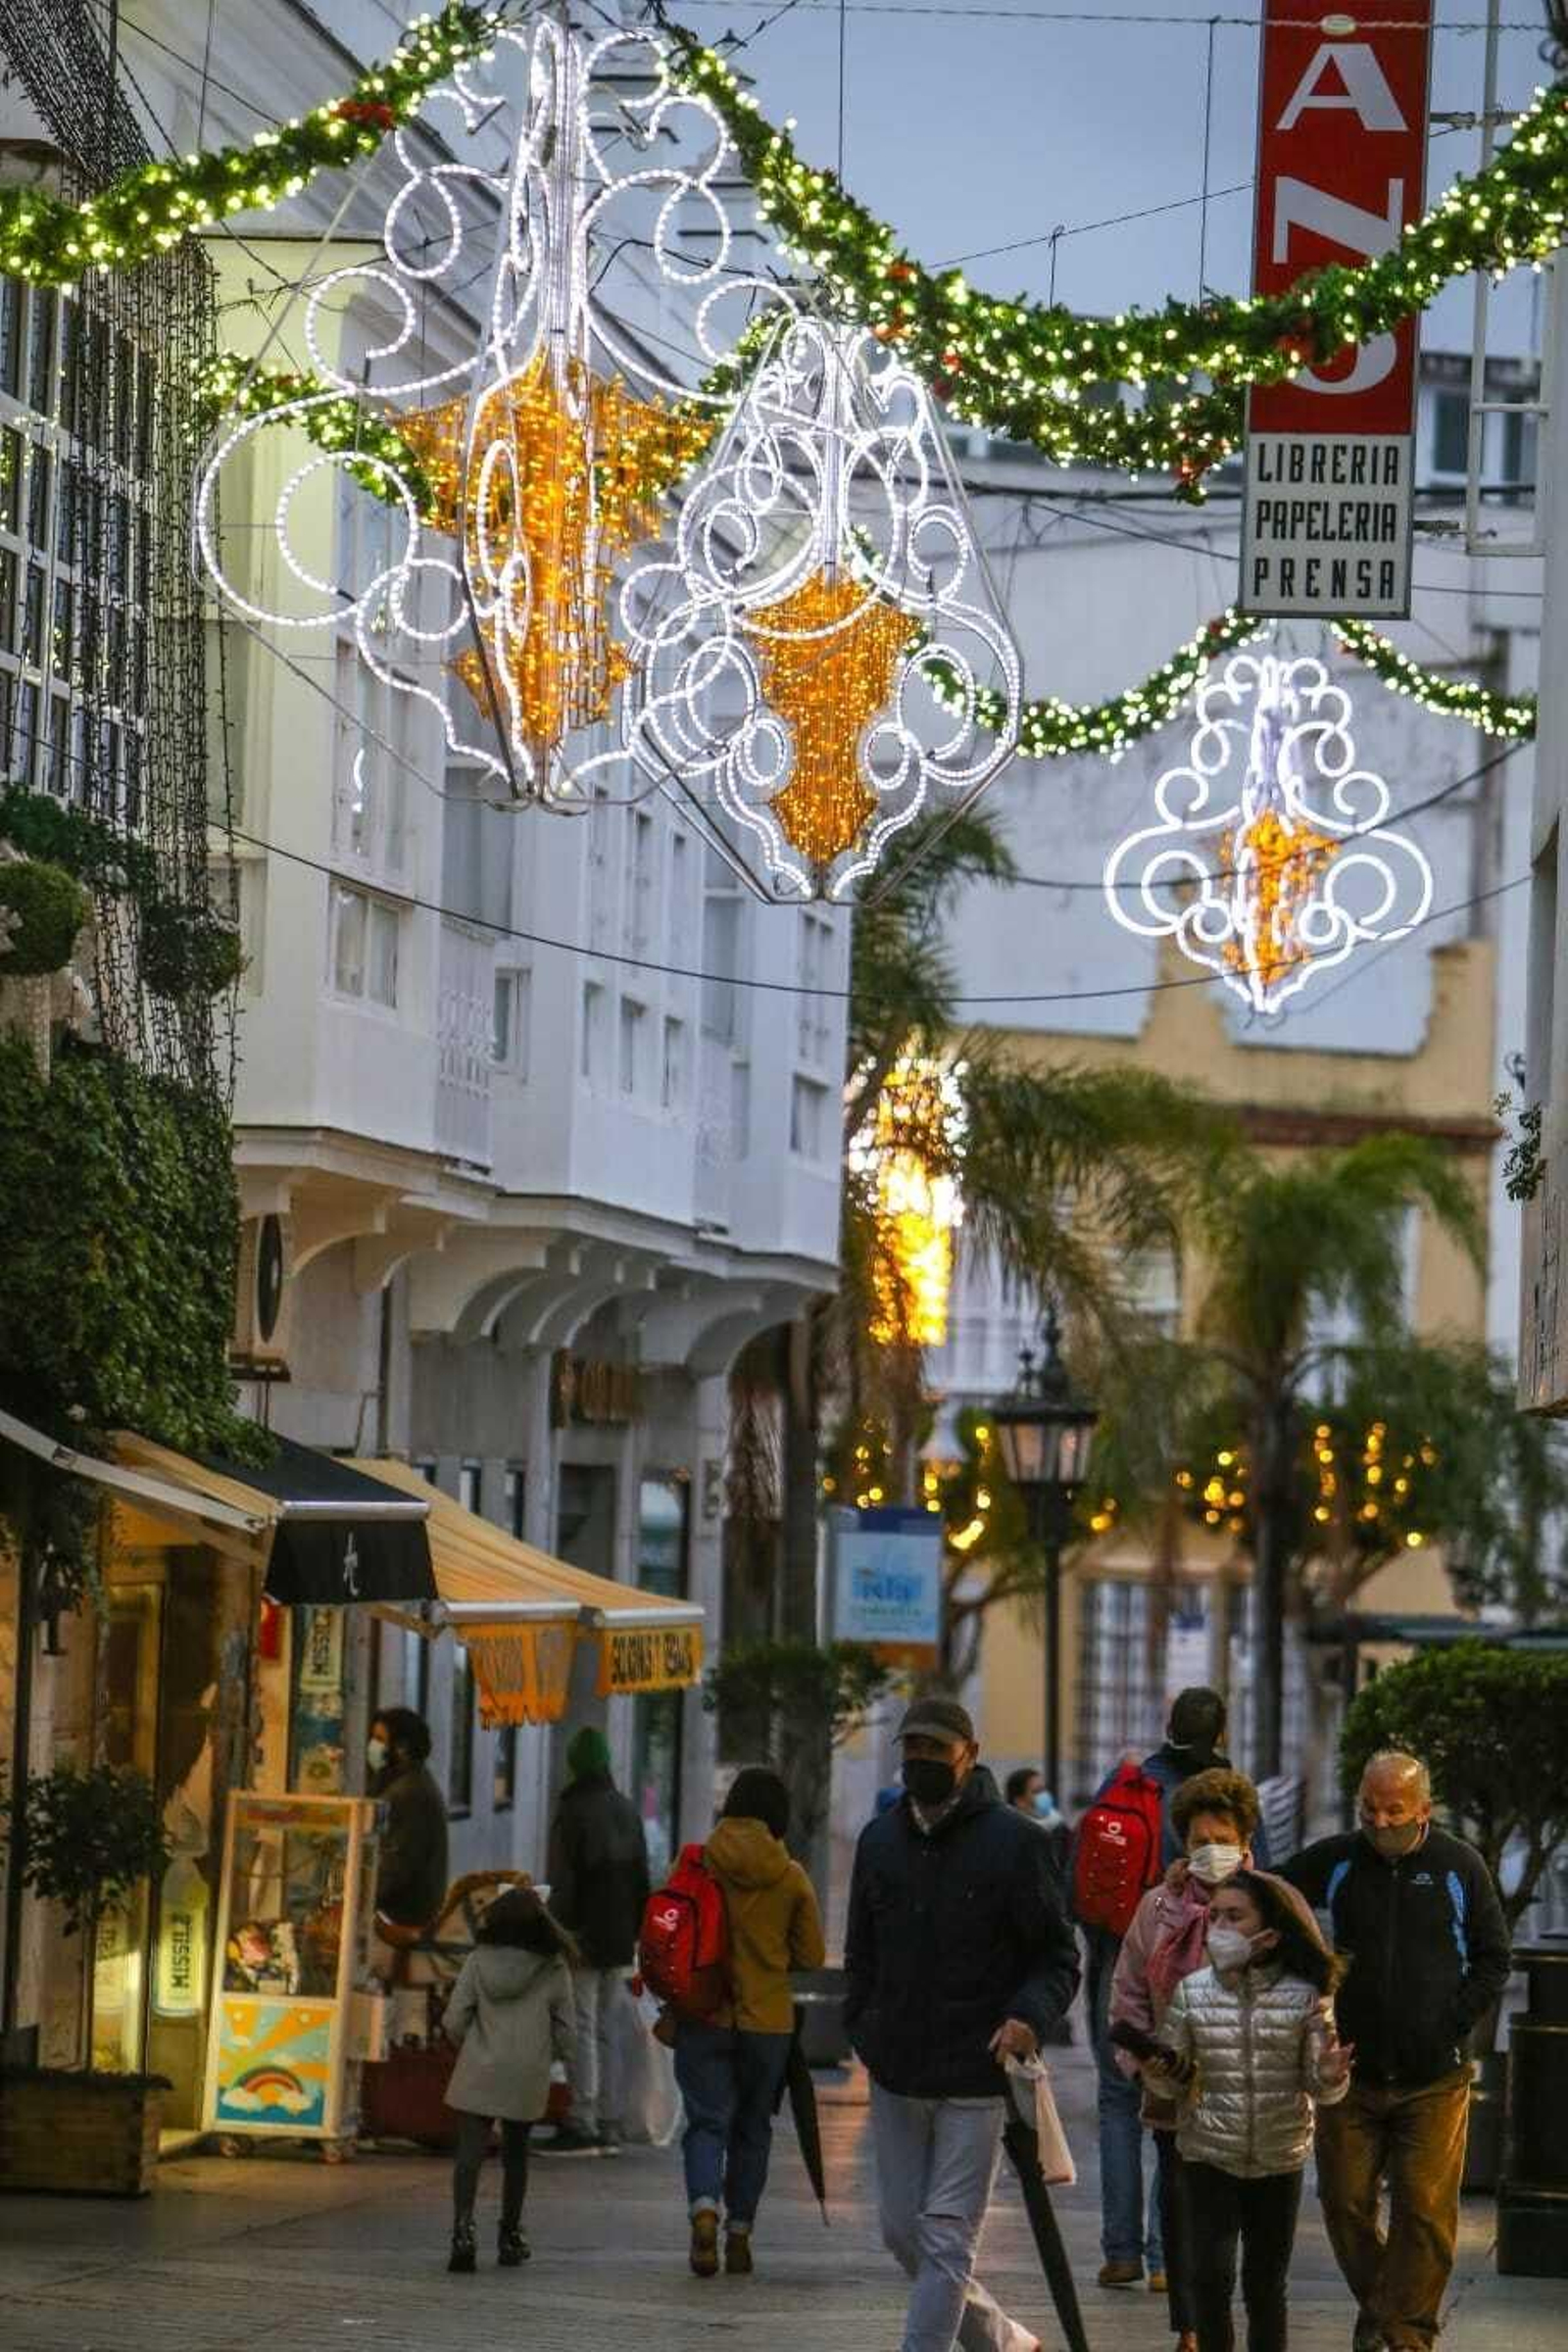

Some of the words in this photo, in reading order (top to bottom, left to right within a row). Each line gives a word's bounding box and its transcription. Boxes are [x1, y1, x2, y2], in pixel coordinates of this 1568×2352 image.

[1257, 443, 1398, 485] LIBRERIA
[1255, 500, 1396, 542] PAPELERIA
[1253, 557, 1395, 600] PRENSA
